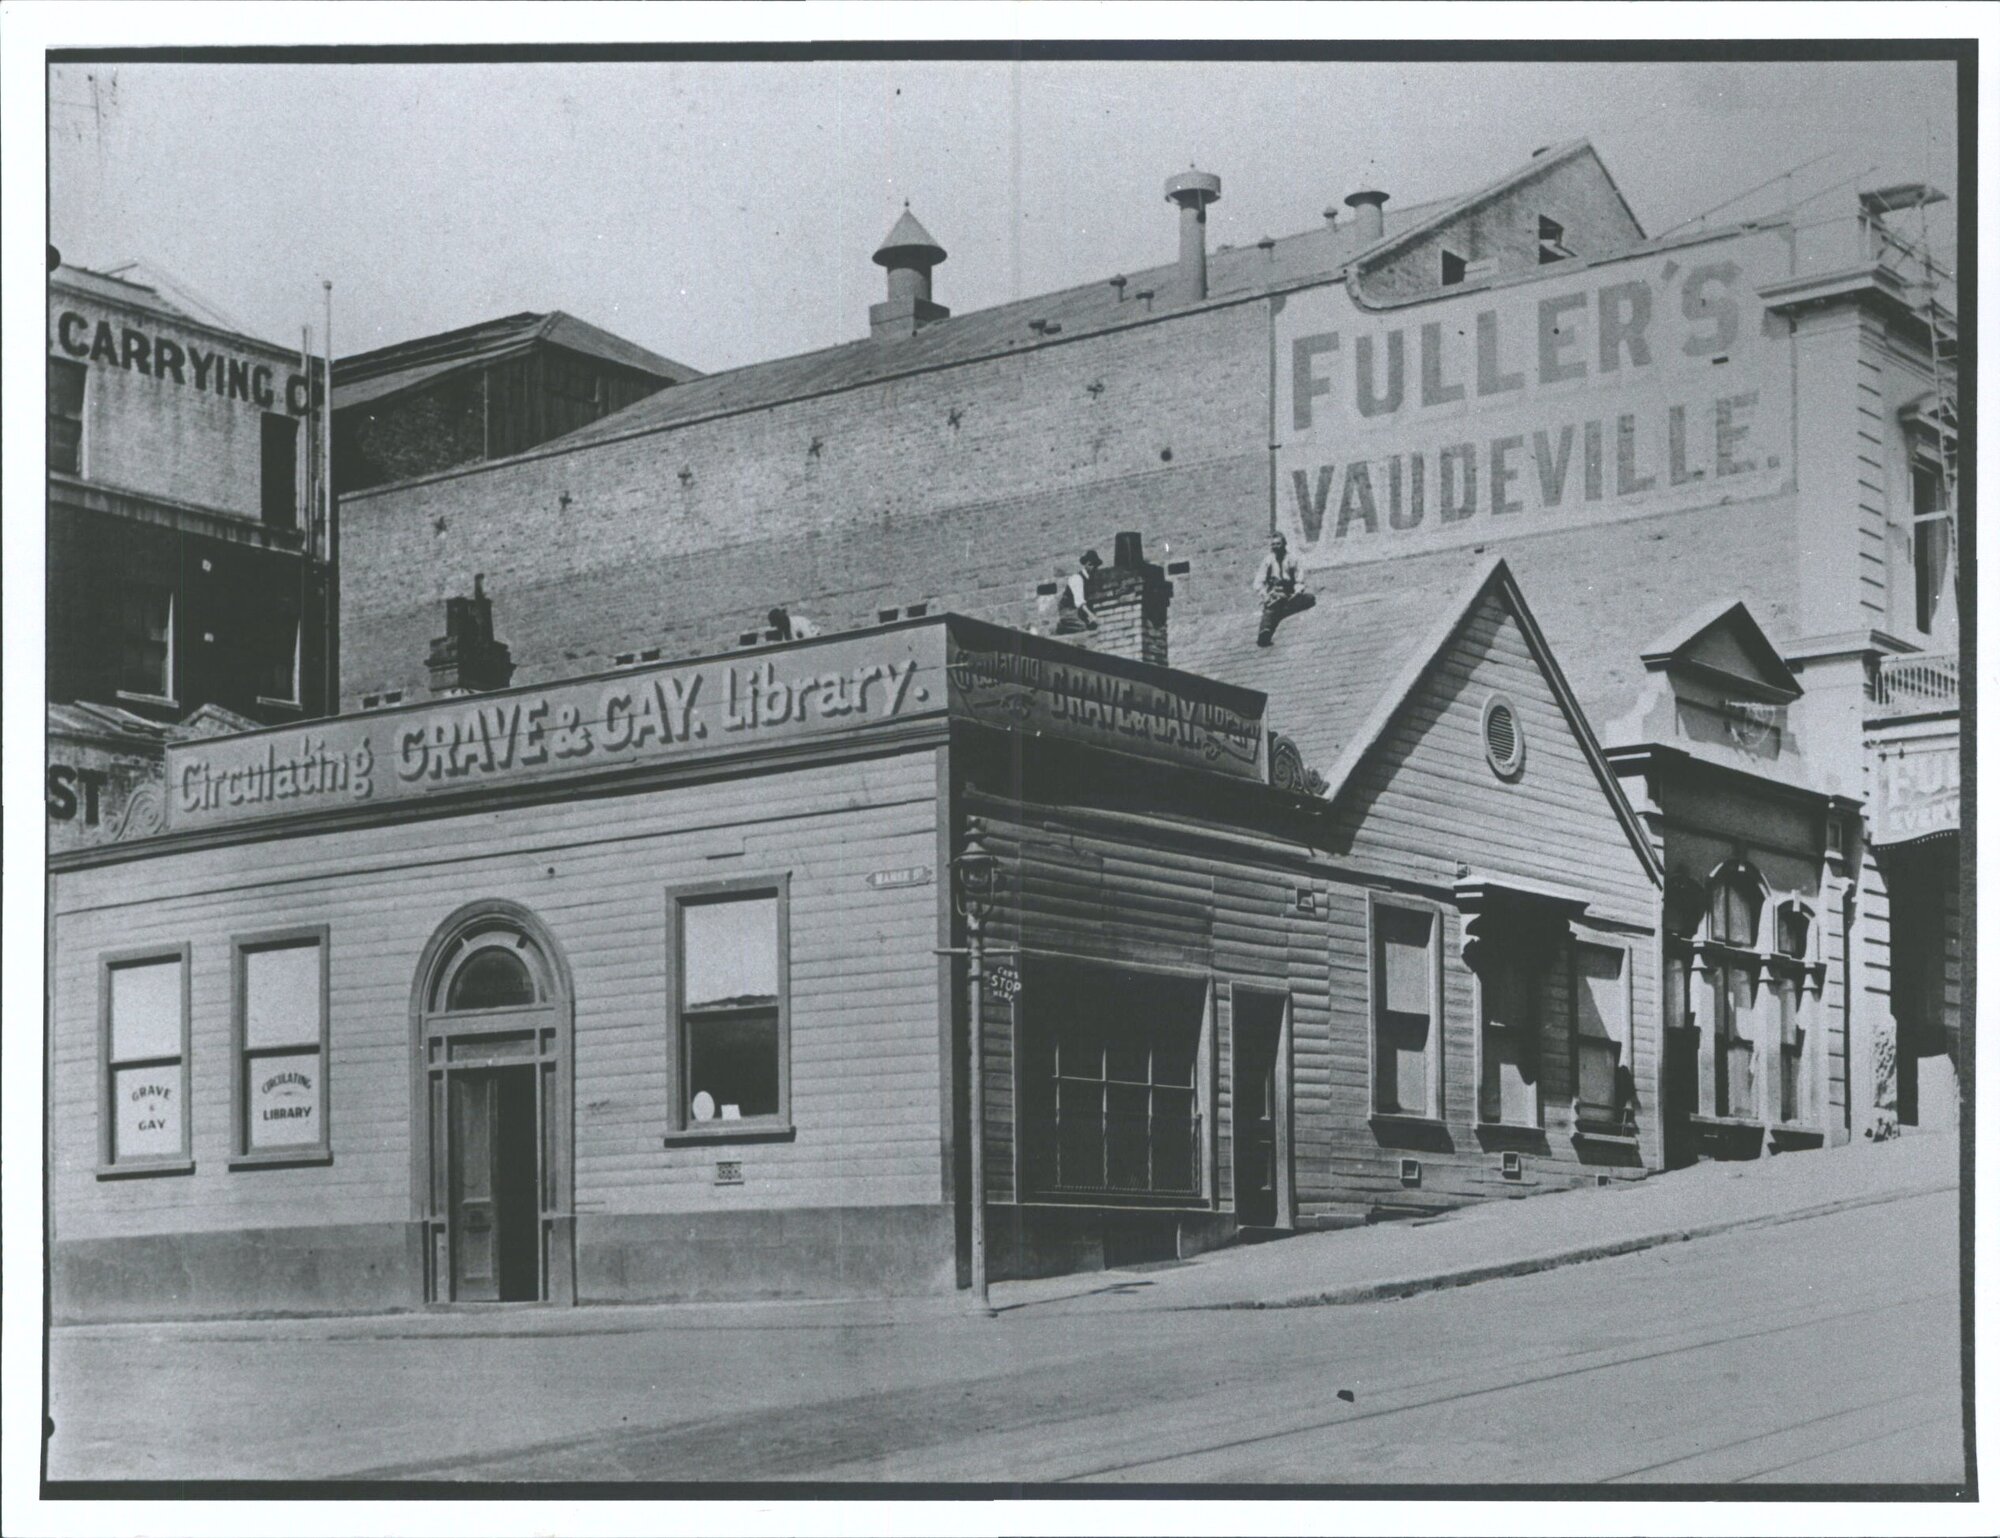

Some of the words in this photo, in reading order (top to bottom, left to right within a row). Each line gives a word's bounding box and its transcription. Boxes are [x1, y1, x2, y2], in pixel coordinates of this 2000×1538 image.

[1292, 259, 1743, 431] FULLER'S
[58, 311, 275, 408] CARRYING
[182, 734, 375, 812] Circulating
[393, 698, 549, 782] GRAVE
[551, 703, 595, 760] &
[990, 974, 1022, 993] STOP
[131, 1085, 172, 1102] GRAVE
[261, 1072, 312, 1095] CIRCULATING
[262, 1106, 312, 1121] LIBRARY
[138, 1118, 166, 1131] GAY
